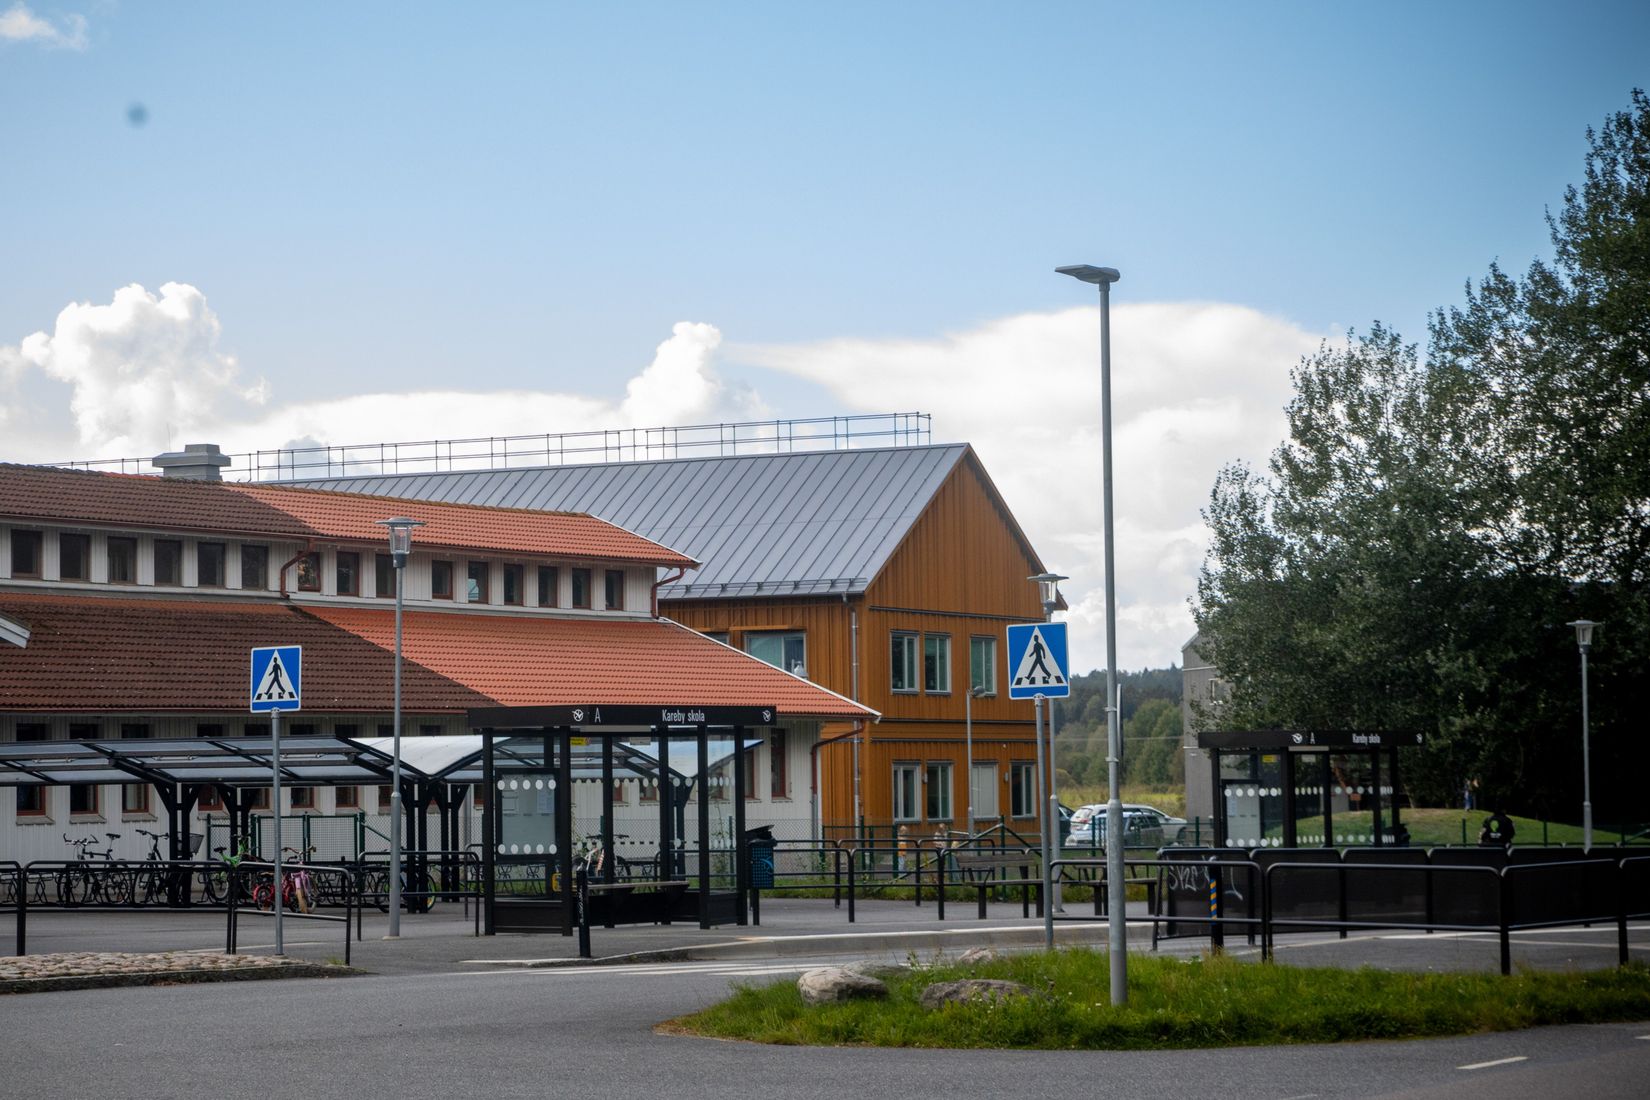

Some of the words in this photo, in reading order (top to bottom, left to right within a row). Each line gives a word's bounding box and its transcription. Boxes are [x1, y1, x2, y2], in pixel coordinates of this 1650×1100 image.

[594, 707, 602, 723] A
[662, 709, 686, 724] Kareby
[687, 710, 706, 722] skola
